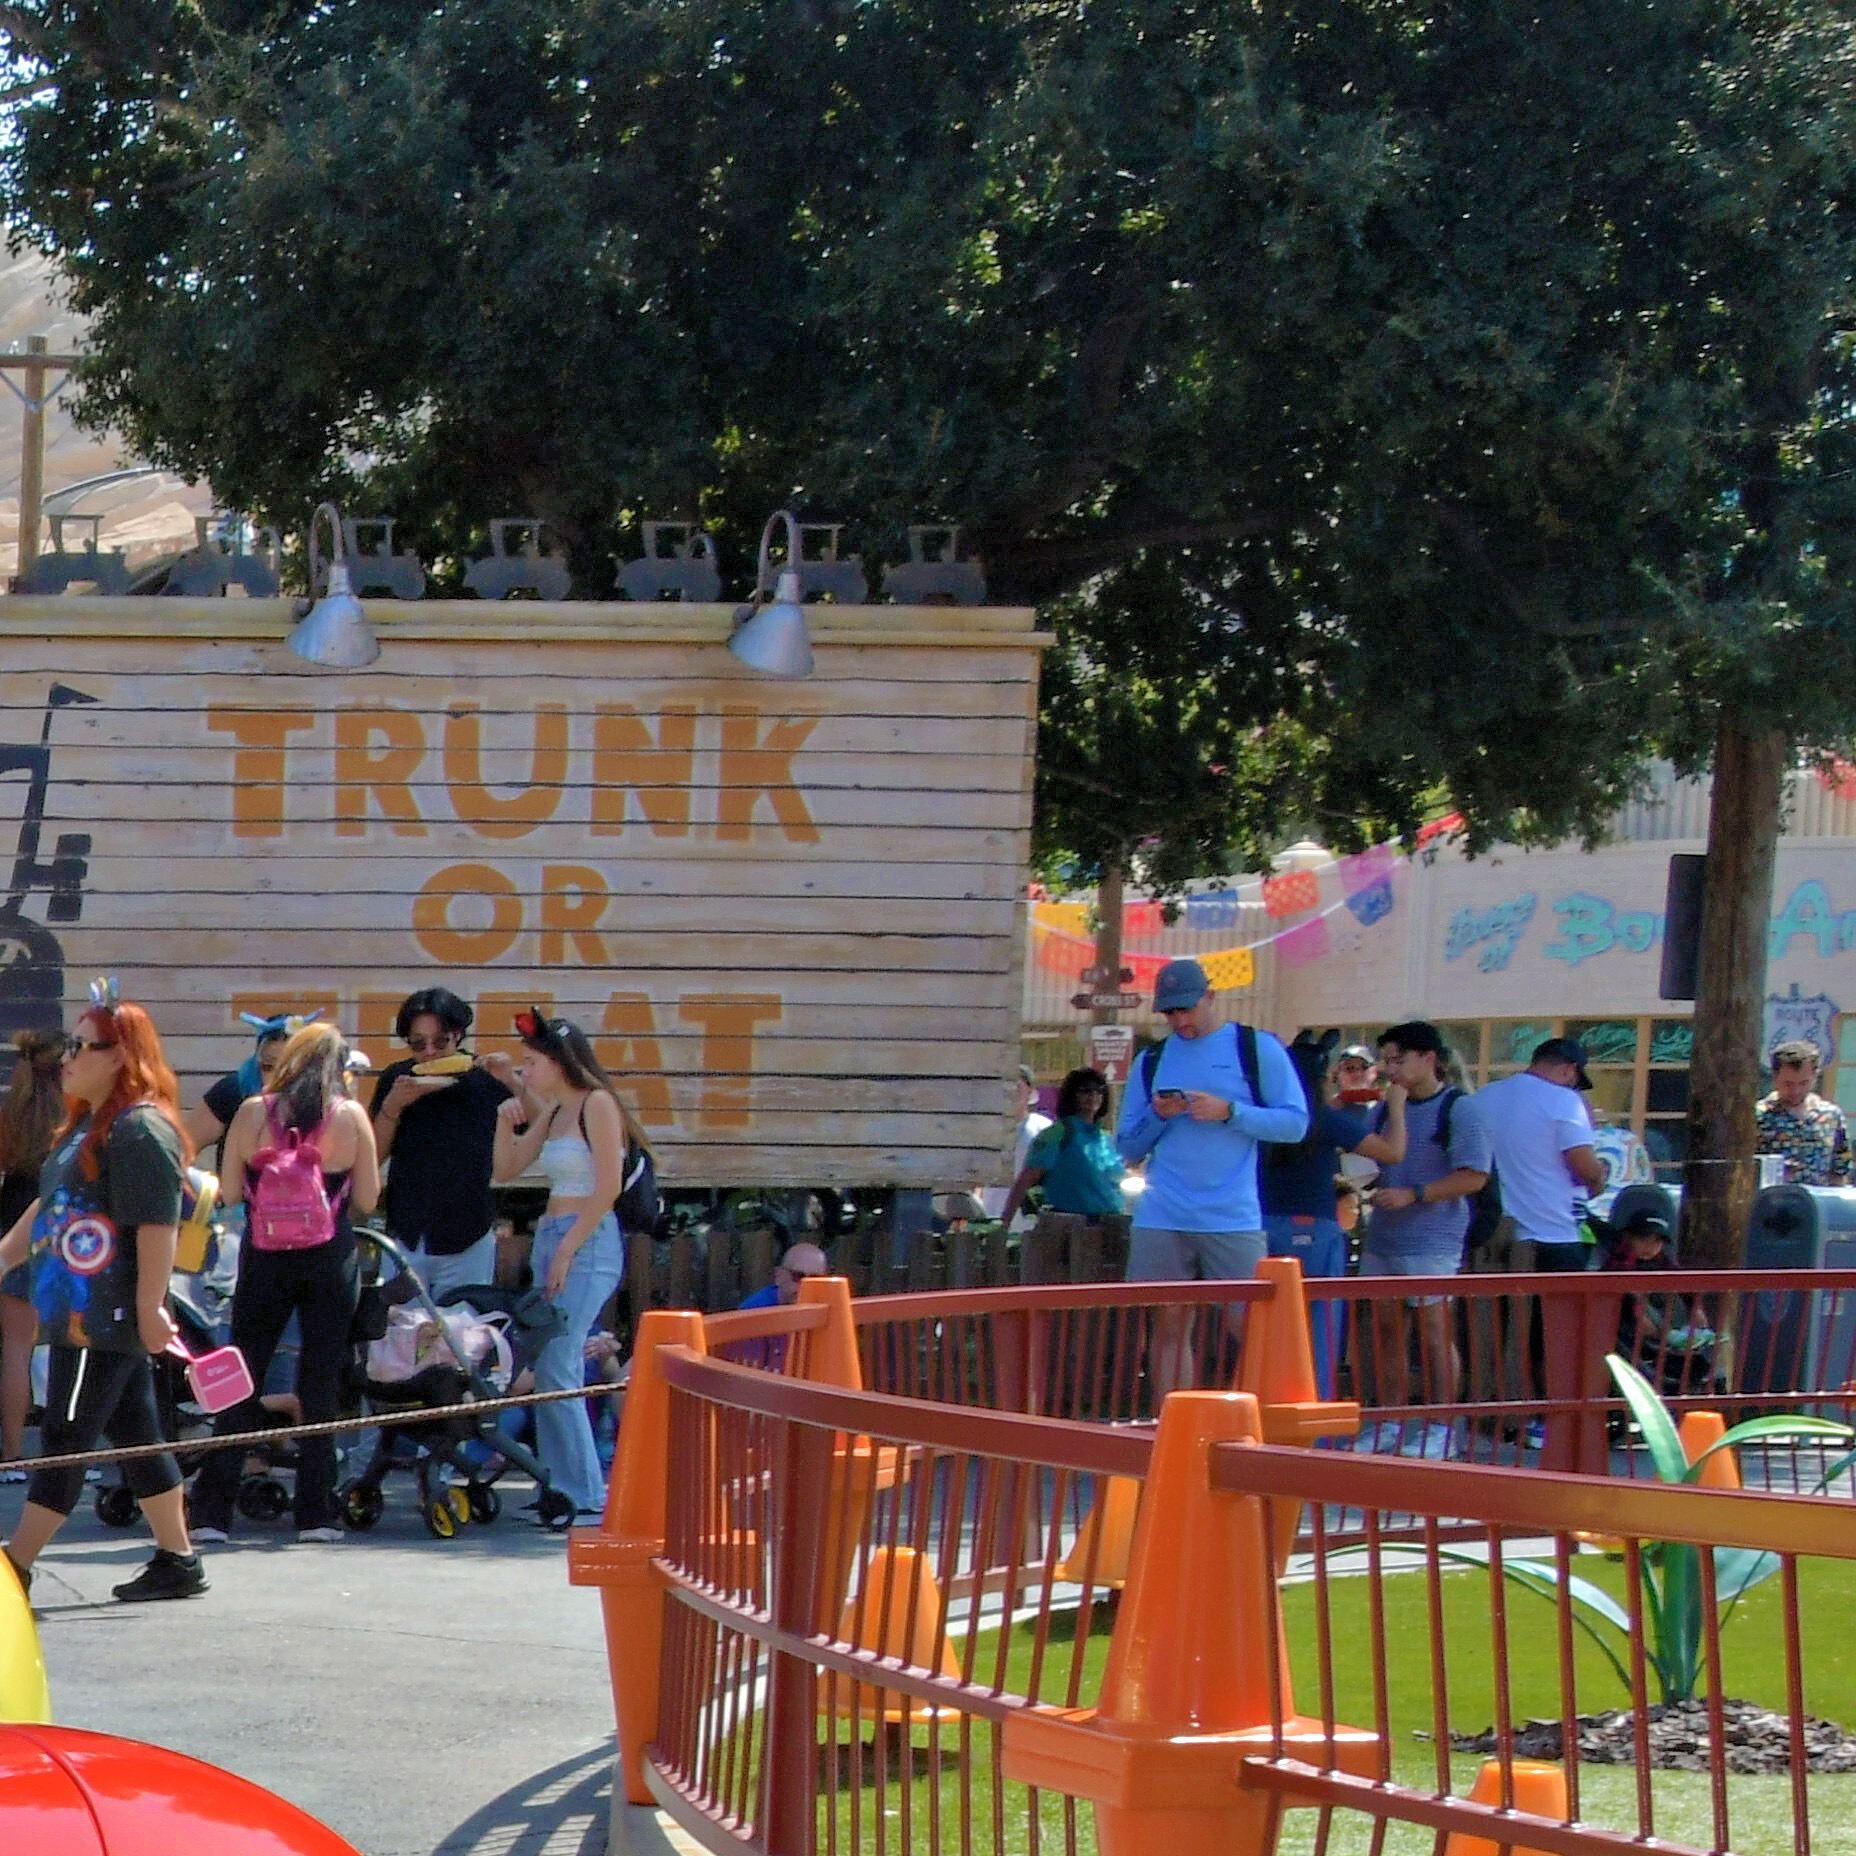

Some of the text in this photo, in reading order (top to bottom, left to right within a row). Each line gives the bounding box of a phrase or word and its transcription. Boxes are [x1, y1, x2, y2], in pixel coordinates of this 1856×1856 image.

[207, 701, 822, 844] TRUNK
[411, 863, 613, 966] OR
[1544, 892, 1666, 967] Bo
